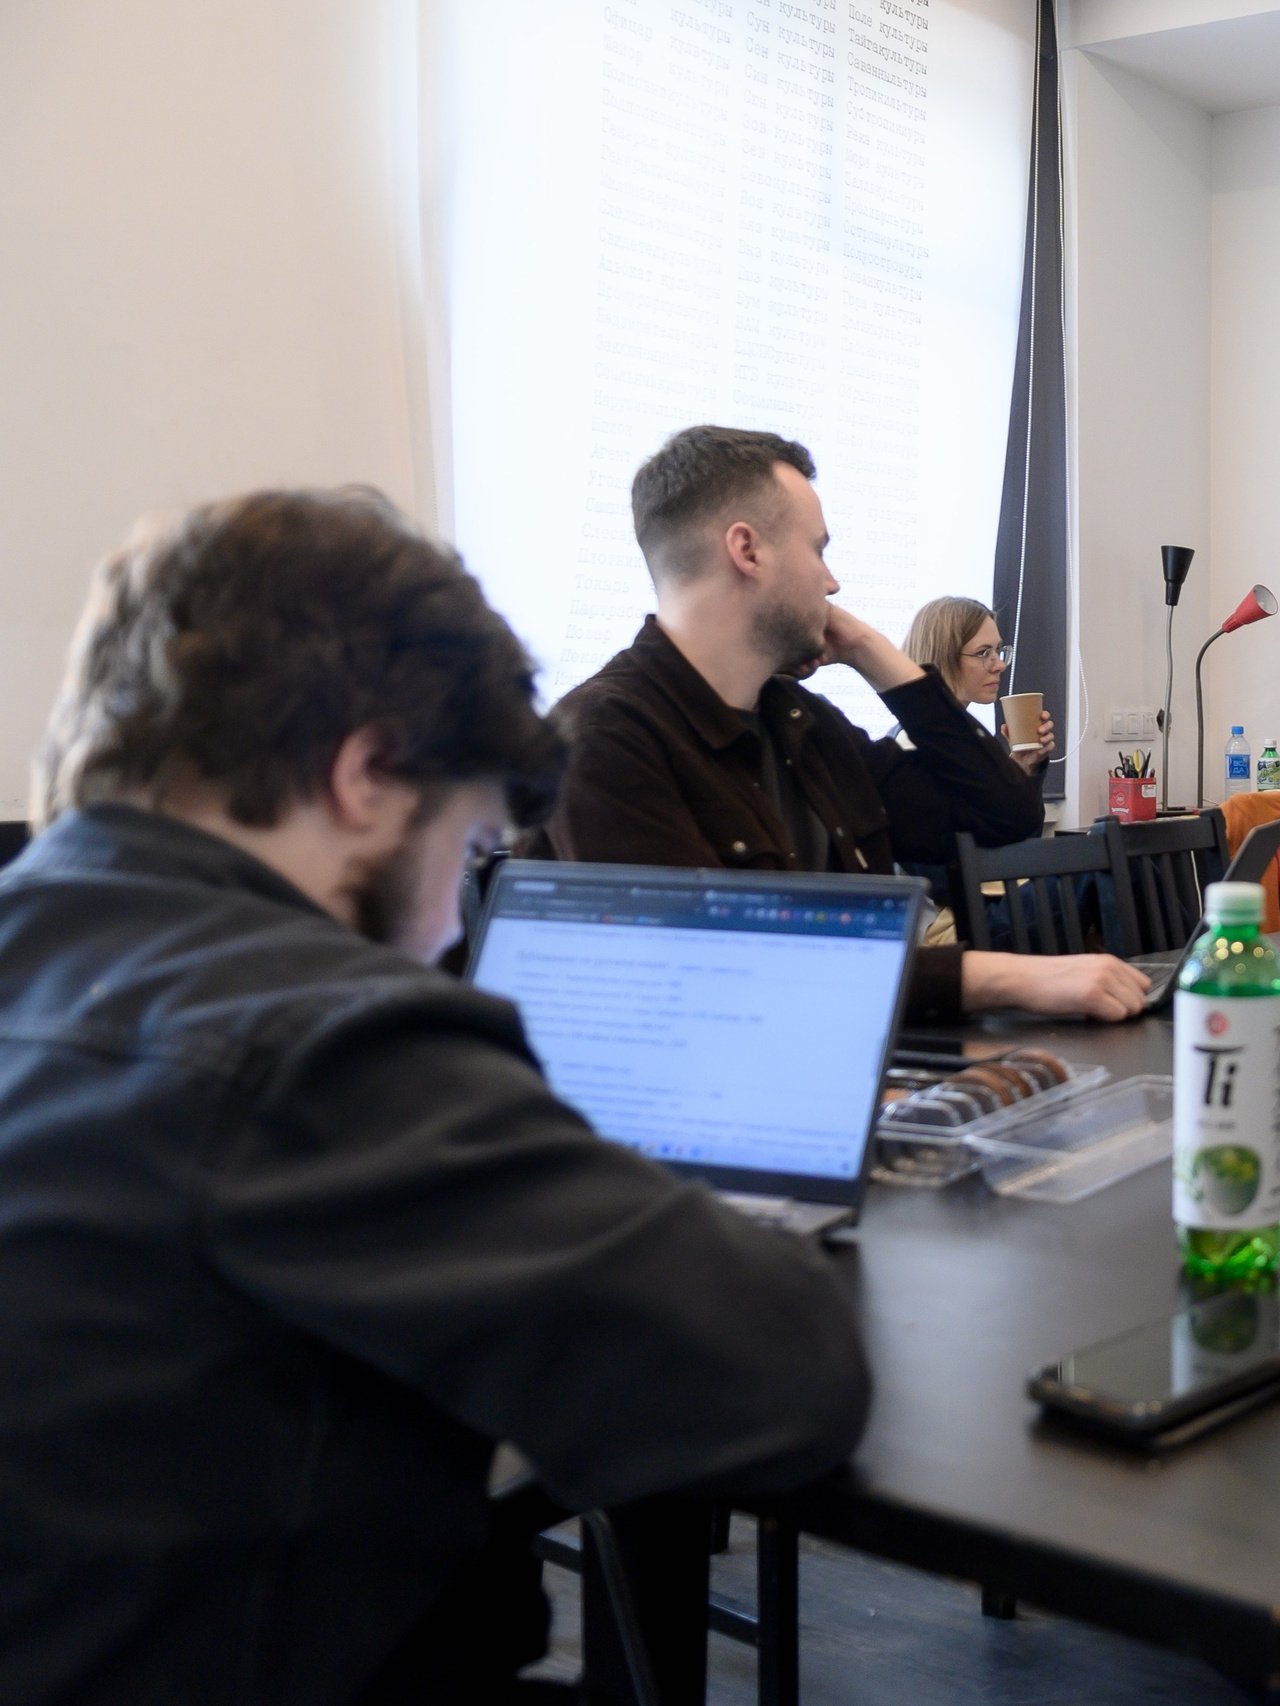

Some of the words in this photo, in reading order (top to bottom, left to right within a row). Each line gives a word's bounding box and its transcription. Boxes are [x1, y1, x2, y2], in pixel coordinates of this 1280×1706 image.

[603, 6, 653, 42] Офицер
[746, 10, 770, 33] Сун
[778, 26, 835, 58] культуры
[779, 1, 836, 34] культуры
[848, 3, 873, 27] Поле
[879, 22, 929, 53] культуры
[603, 33, 645, 66] Майор
[745, 37, 769, 59] Сен
[777, 51, 835, 83] культуры
[847, 27, 928, 75] Тайгакультуры
[847, 51, 928, 99] Саванныльтуры
[600, 115, 657, 150] Генерал
